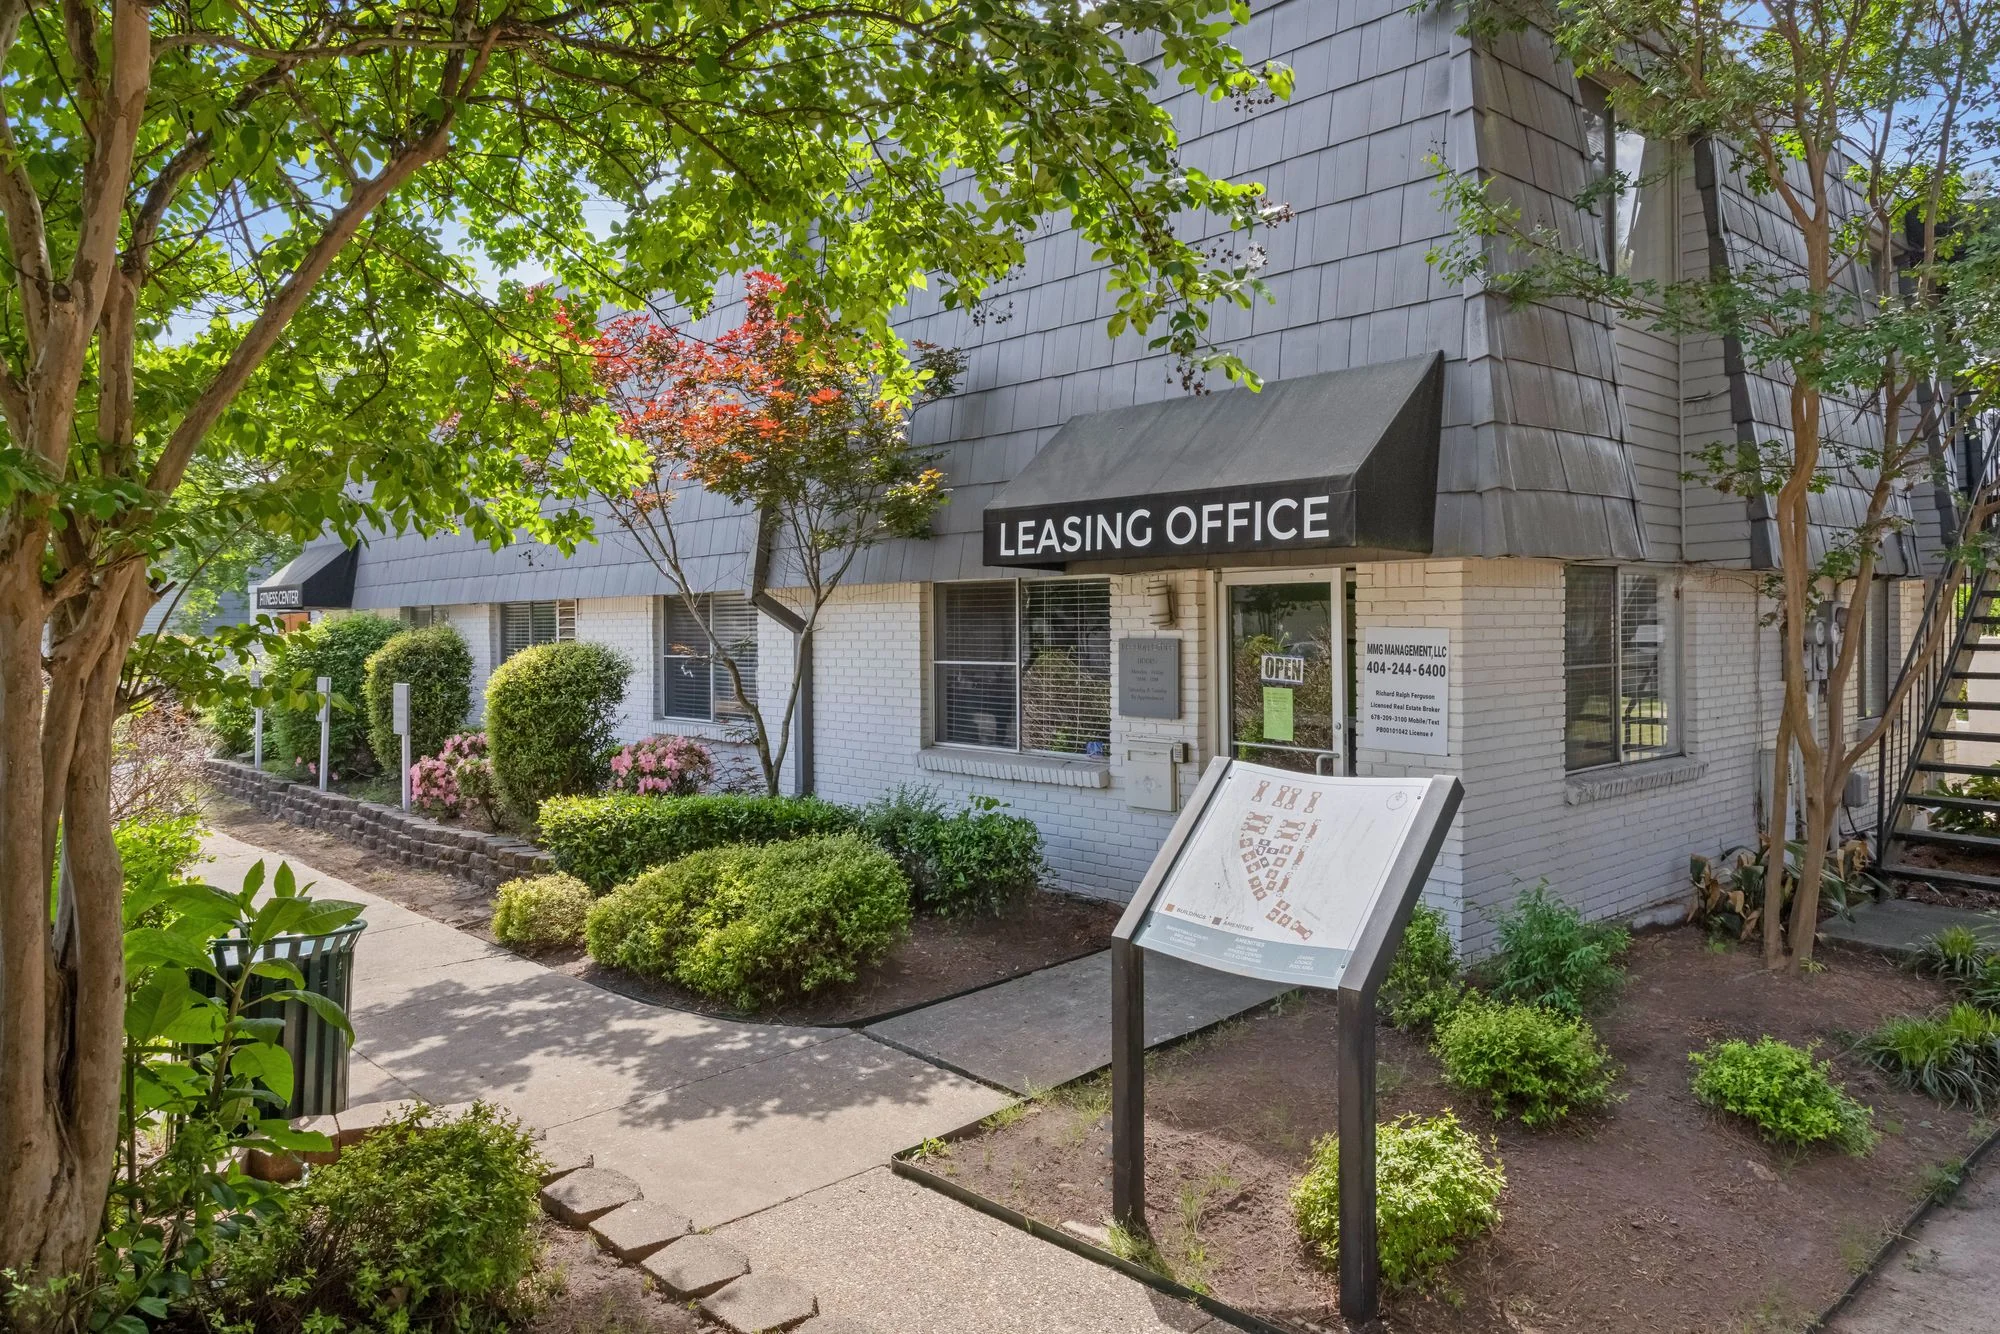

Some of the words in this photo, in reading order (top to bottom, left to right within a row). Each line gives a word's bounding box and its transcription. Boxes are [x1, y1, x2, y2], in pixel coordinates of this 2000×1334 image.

[999, 508, 1152, 556] LEASING
[1165, 495, 1330, 545] OFFICE
[260, 591, 278, 606] FITNESS
[278, 590, 299, 605] CENTER
[1366, 643, 1384, 655] MMG
[1265, 657, 1300, 681] OPEN
[1366, 661, 1446, 678] 404-244-6400
[1411, 692, 1435, 700] Ferguson
[1405, 704, 1422, 712] Estate
[1422, 705, 1441, 713] Broker
[1408, 717, 1440, 726] Mobile/Text
[1176, 907, 1207, 920] BUILDINGS
[1223, 920, 1255, 932] AMENITIES
[1234, 937, 1266, 949] AMENITIES
